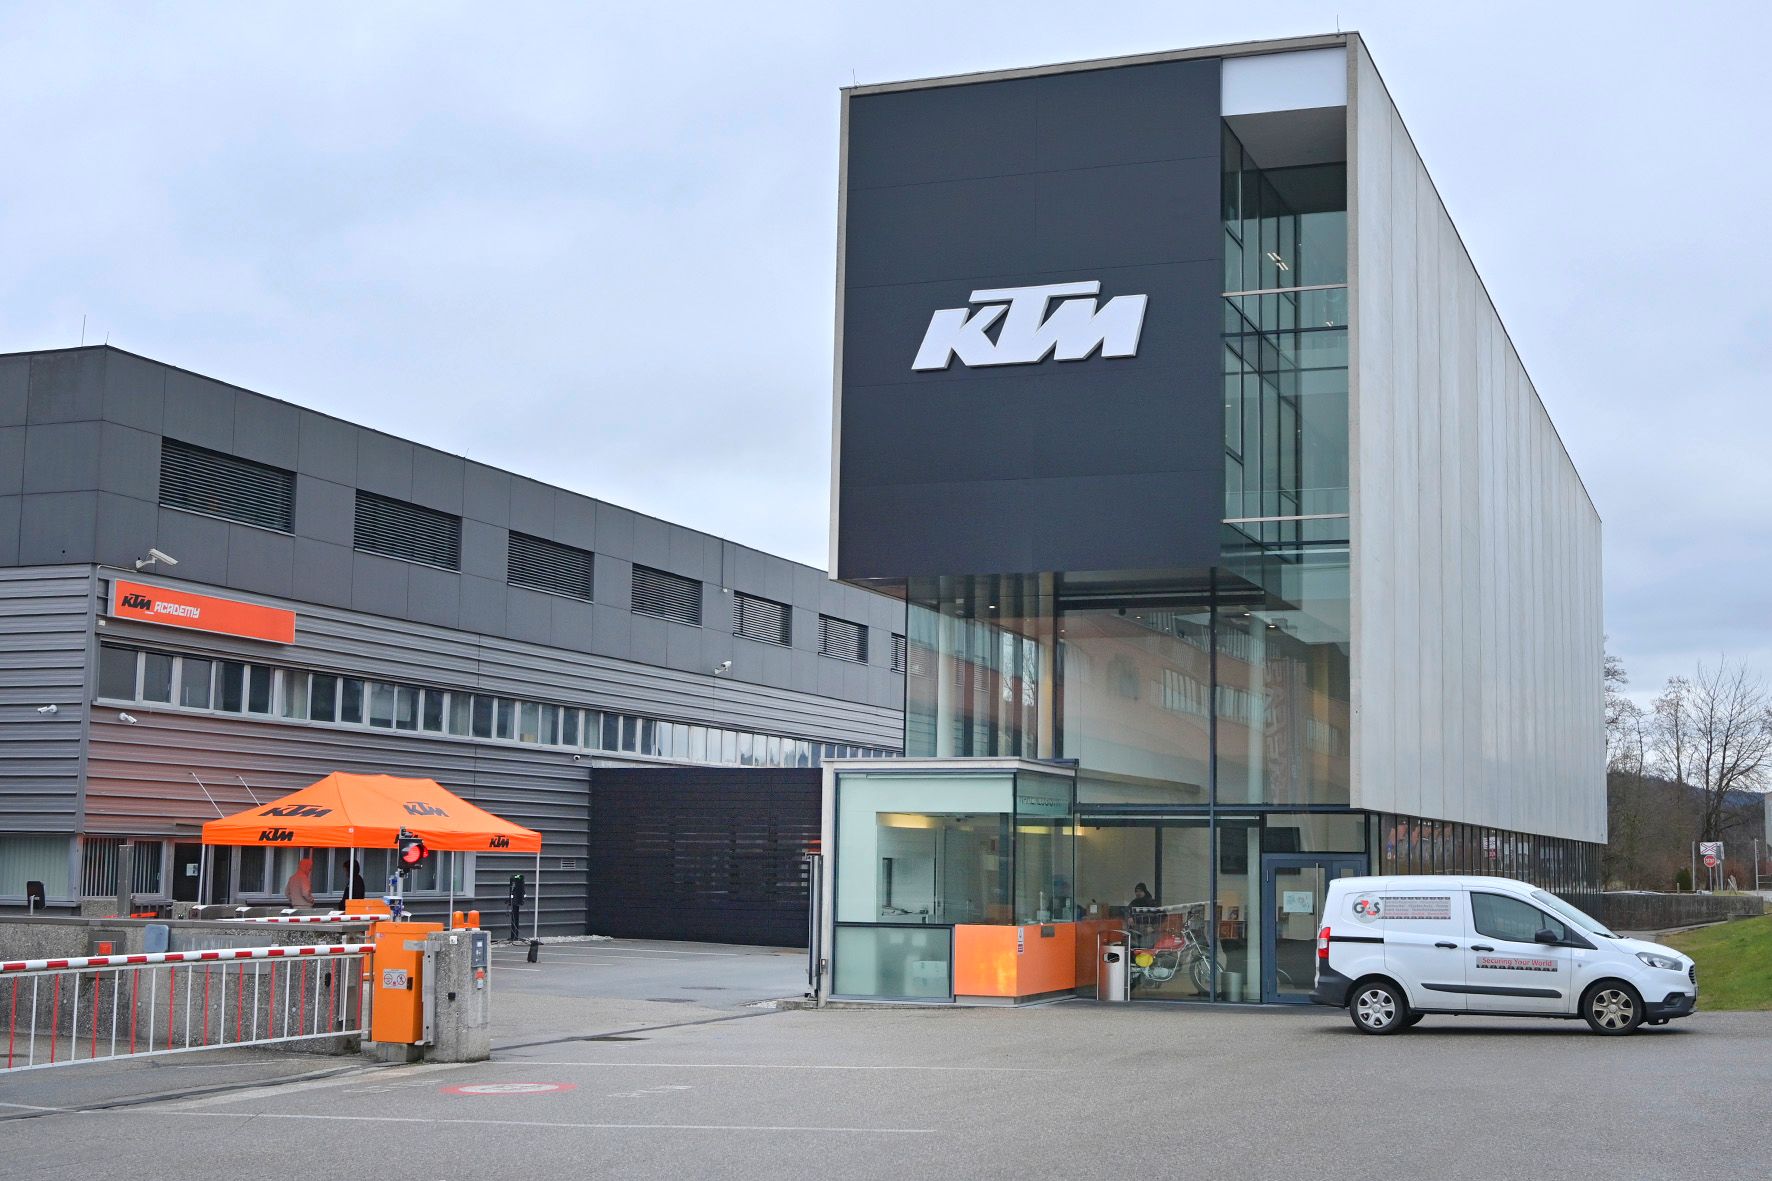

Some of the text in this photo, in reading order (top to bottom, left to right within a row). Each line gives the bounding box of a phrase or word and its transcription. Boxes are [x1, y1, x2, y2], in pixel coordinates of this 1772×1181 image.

[911, 280, 1148, 371] KTM
[121, 593, 152, 611] KTM
[258, 804, 334, 817] KTM
[403, 801, 450, 817] KTM
[258, 827, 295, 842] KTM
[489, 835, 510, 848] KTM
[1353, 899, 1381, 916] G4S
[1482, 957, 1552, 967] Securing Your World
